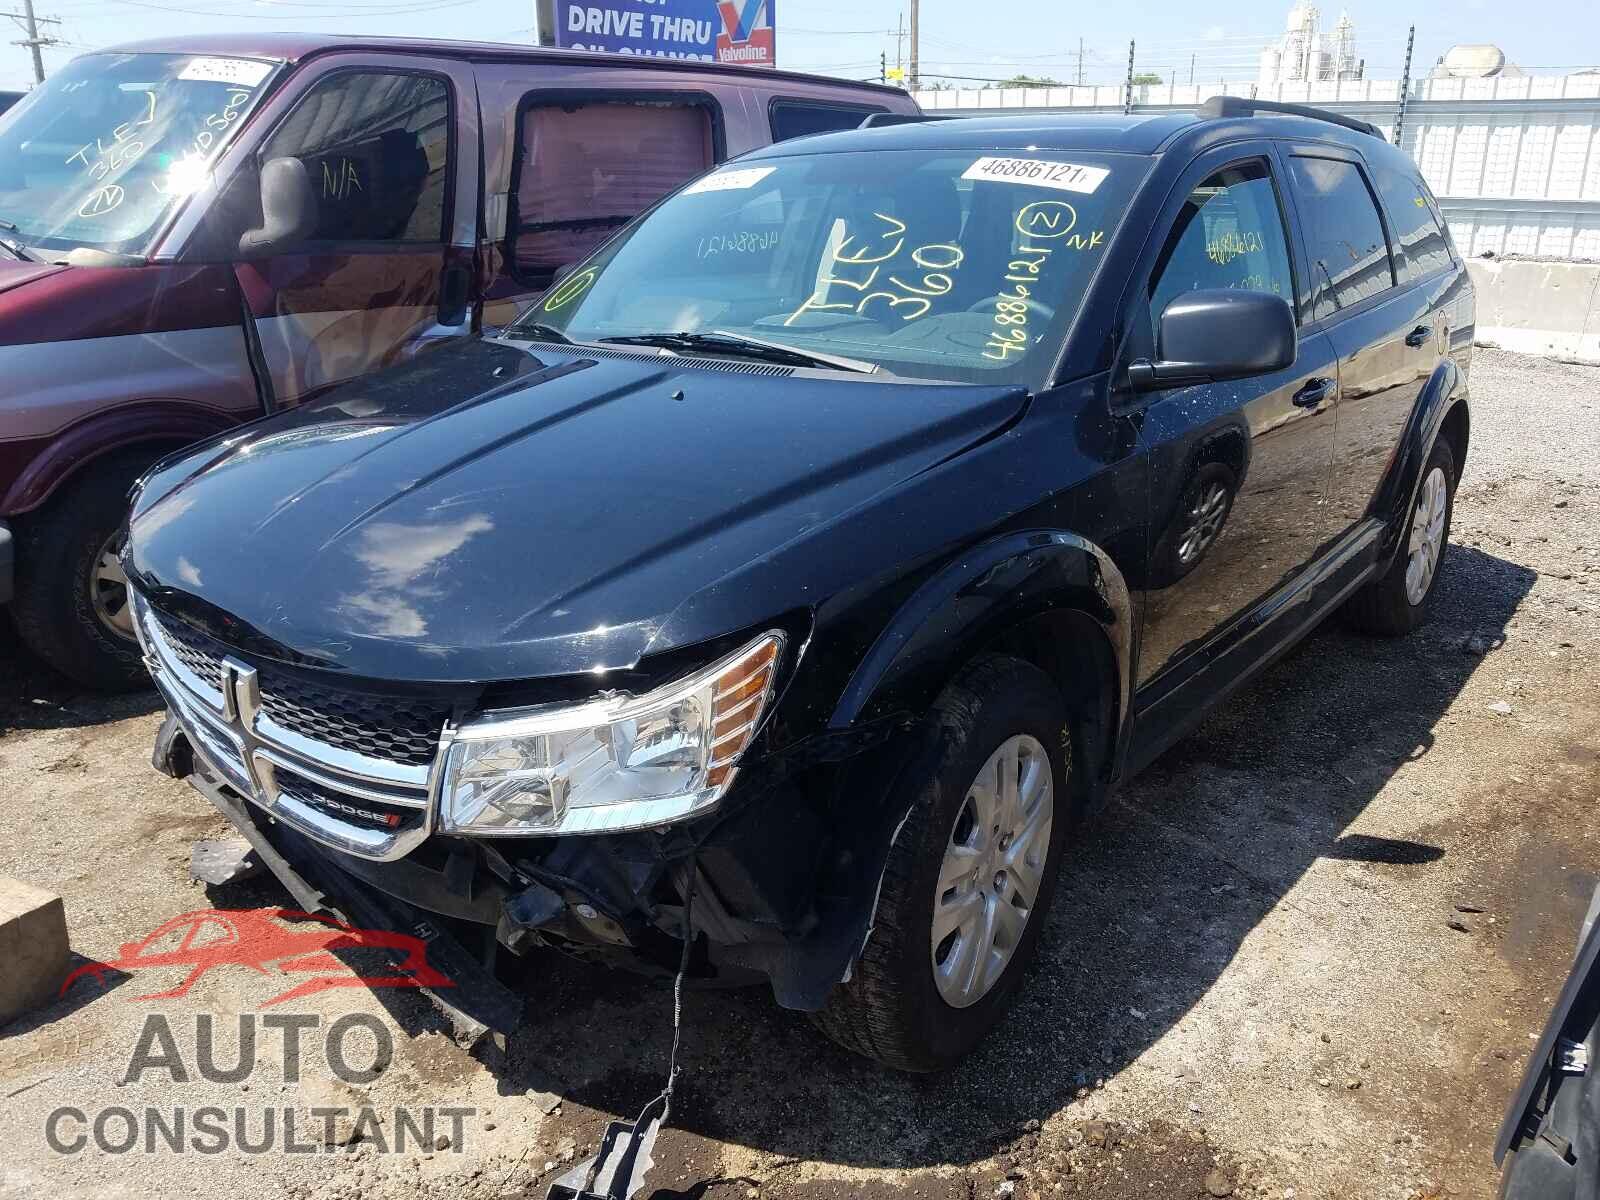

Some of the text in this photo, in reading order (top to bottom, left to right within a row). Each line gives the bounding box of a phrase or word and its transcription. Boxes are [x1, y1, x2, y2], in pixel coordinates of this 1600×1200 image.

[568, 5, 712, 45] DRIVE THRU
[718, 44, 767, 62] Valvoline
[322, 158, 363, 201] N/A
[856, 245, 965, 320] 360
[981, 245, 1053, 360] 46886121
